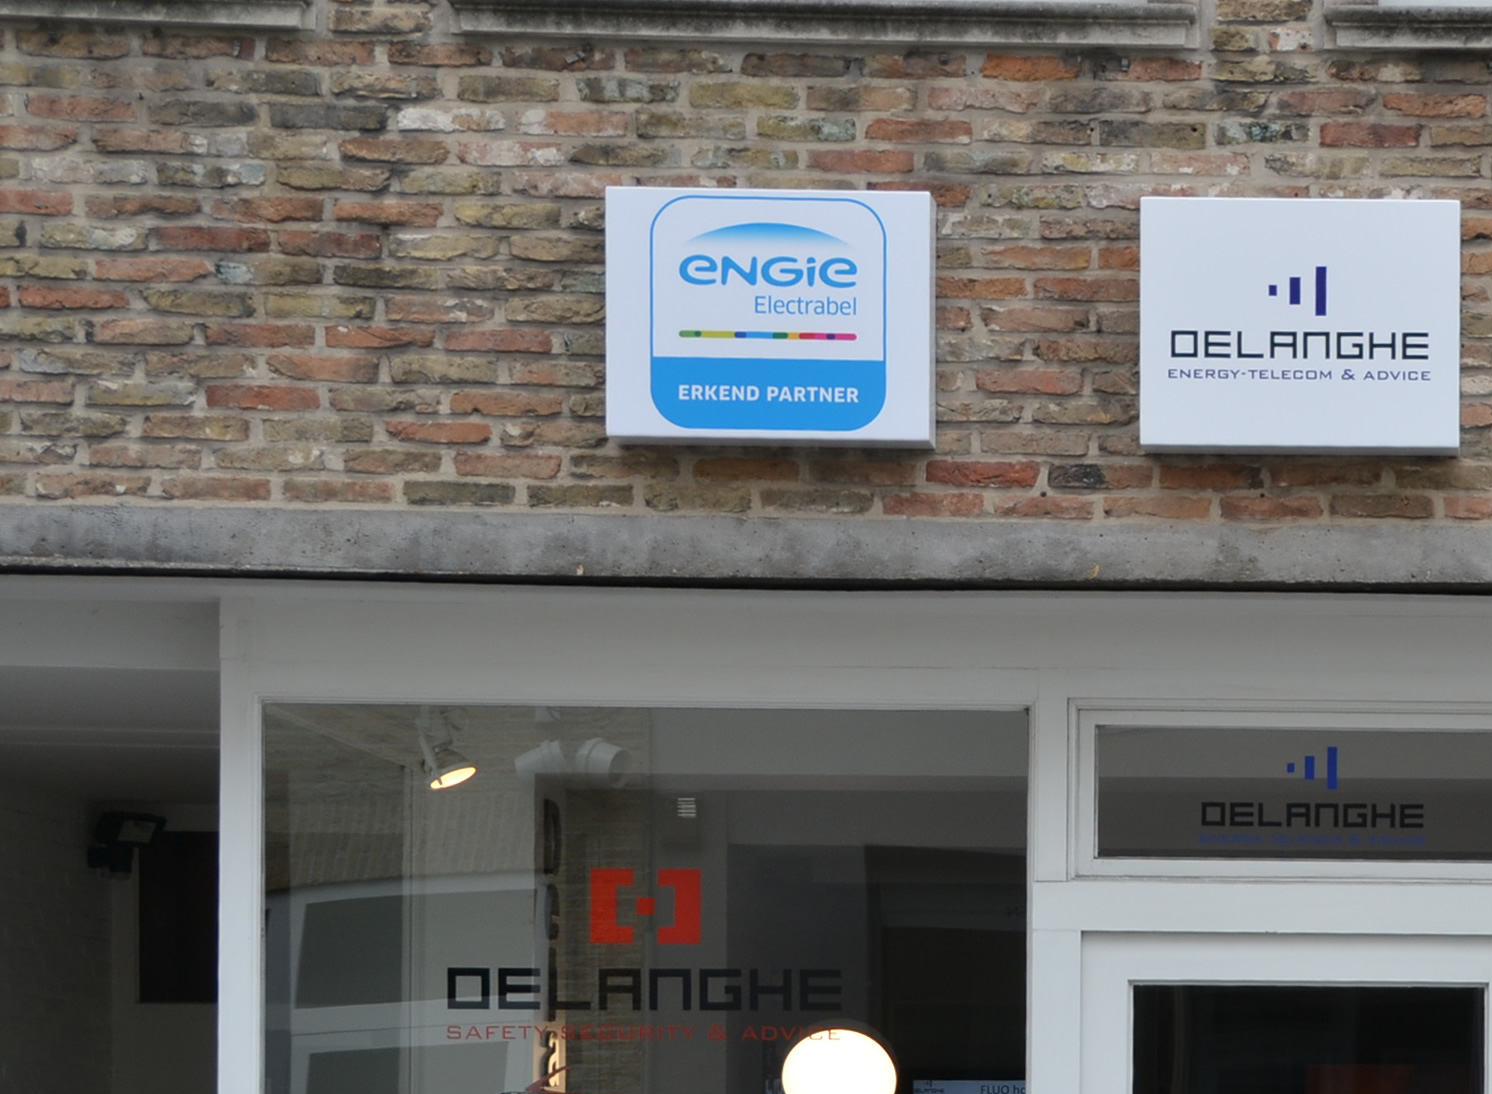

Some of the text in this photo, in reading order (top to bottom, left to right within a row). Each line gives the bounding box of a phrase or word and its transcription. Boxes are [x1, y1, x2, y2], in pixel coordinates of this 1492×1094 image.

[754, 295, 857, 317] Electrabel
[1170, 330, 1429, 360] DELANGHE
[1168, 368, 1431, 381] ENERGY-TELECOM & ADVICE
[678, 384, 860, 404] ERKEND PARTNER
[1200, 801, 1425, 829] DELANGHE
[447, 967, 842, 1012] DELANGHE
[447, 1025, 843, 1041] SAFETY SECURITY & ADVICE
